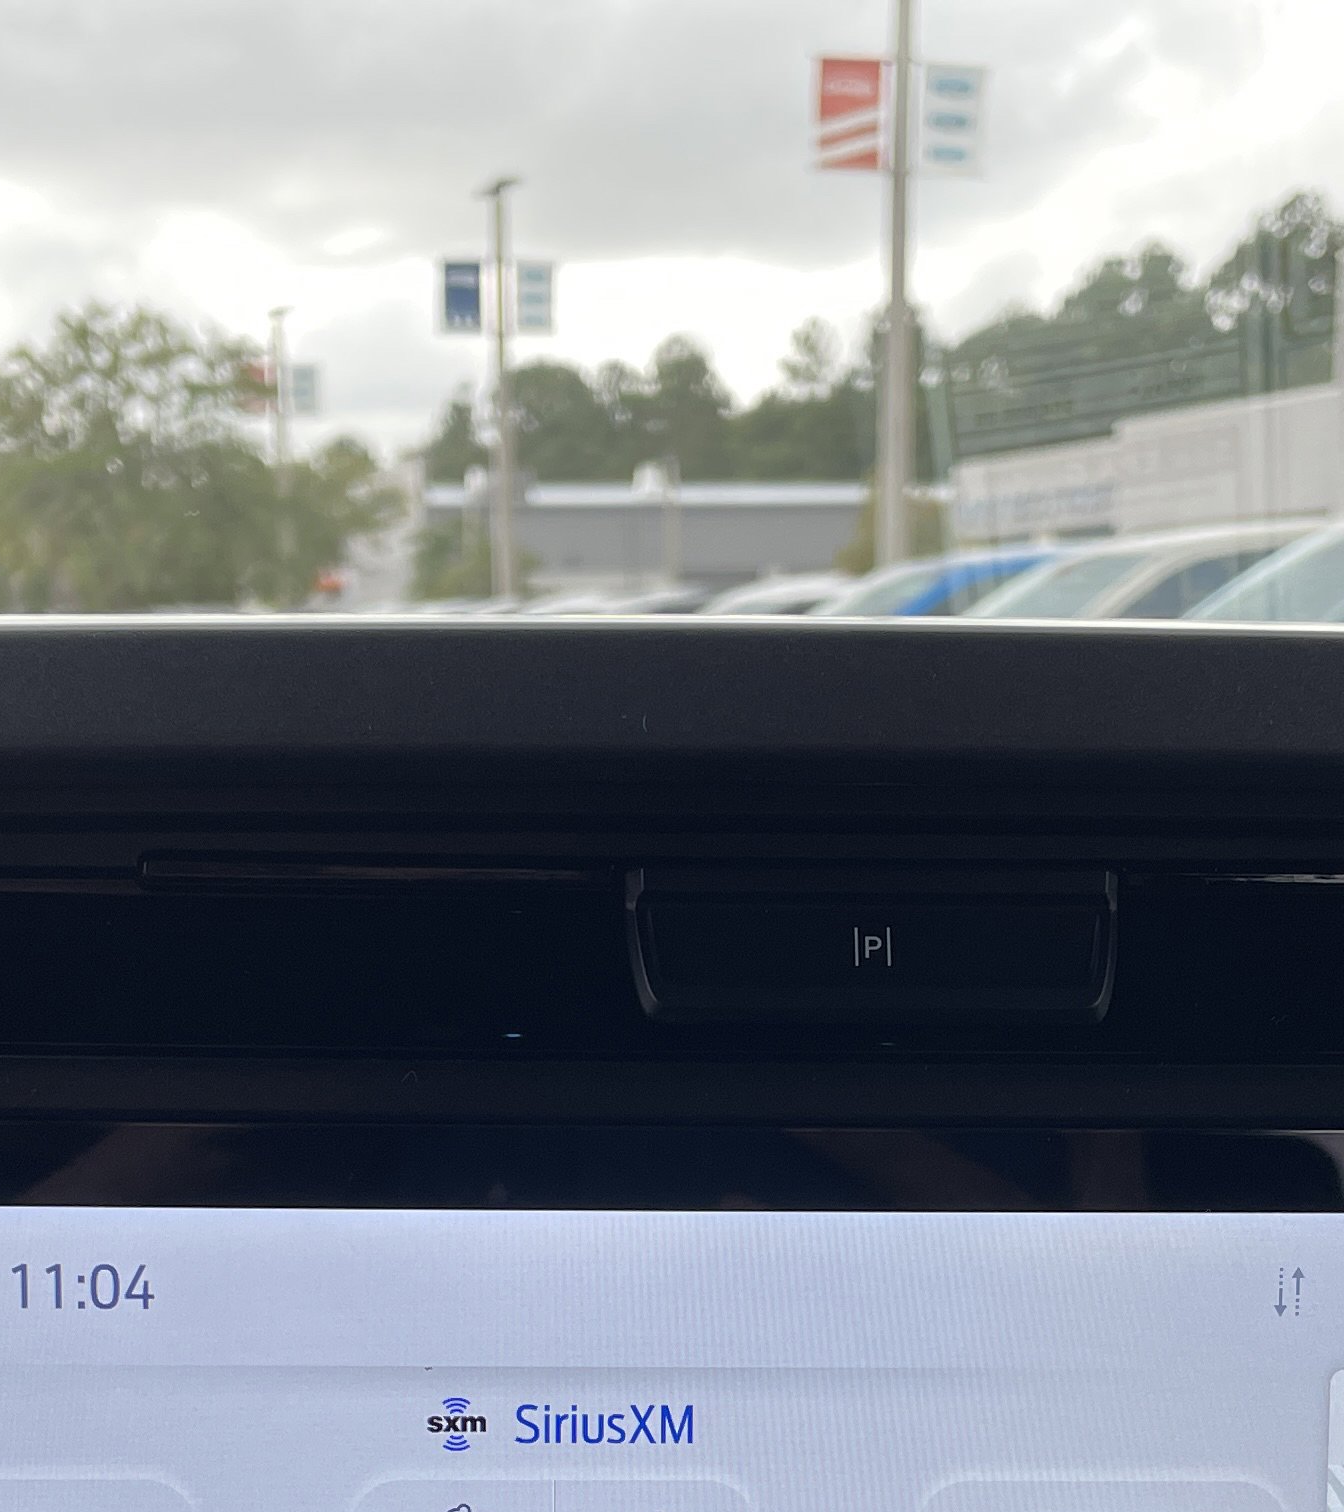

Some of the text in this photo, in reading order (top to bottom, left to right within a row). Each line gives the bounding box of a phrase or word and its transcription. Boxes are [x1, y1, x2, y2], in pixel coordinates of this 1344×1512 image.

[11, 1263, 155, 1310] 11:04
[423, 1408, 489, 1435] sxm
[515, 1403, 694, 1444] SiriusXM
